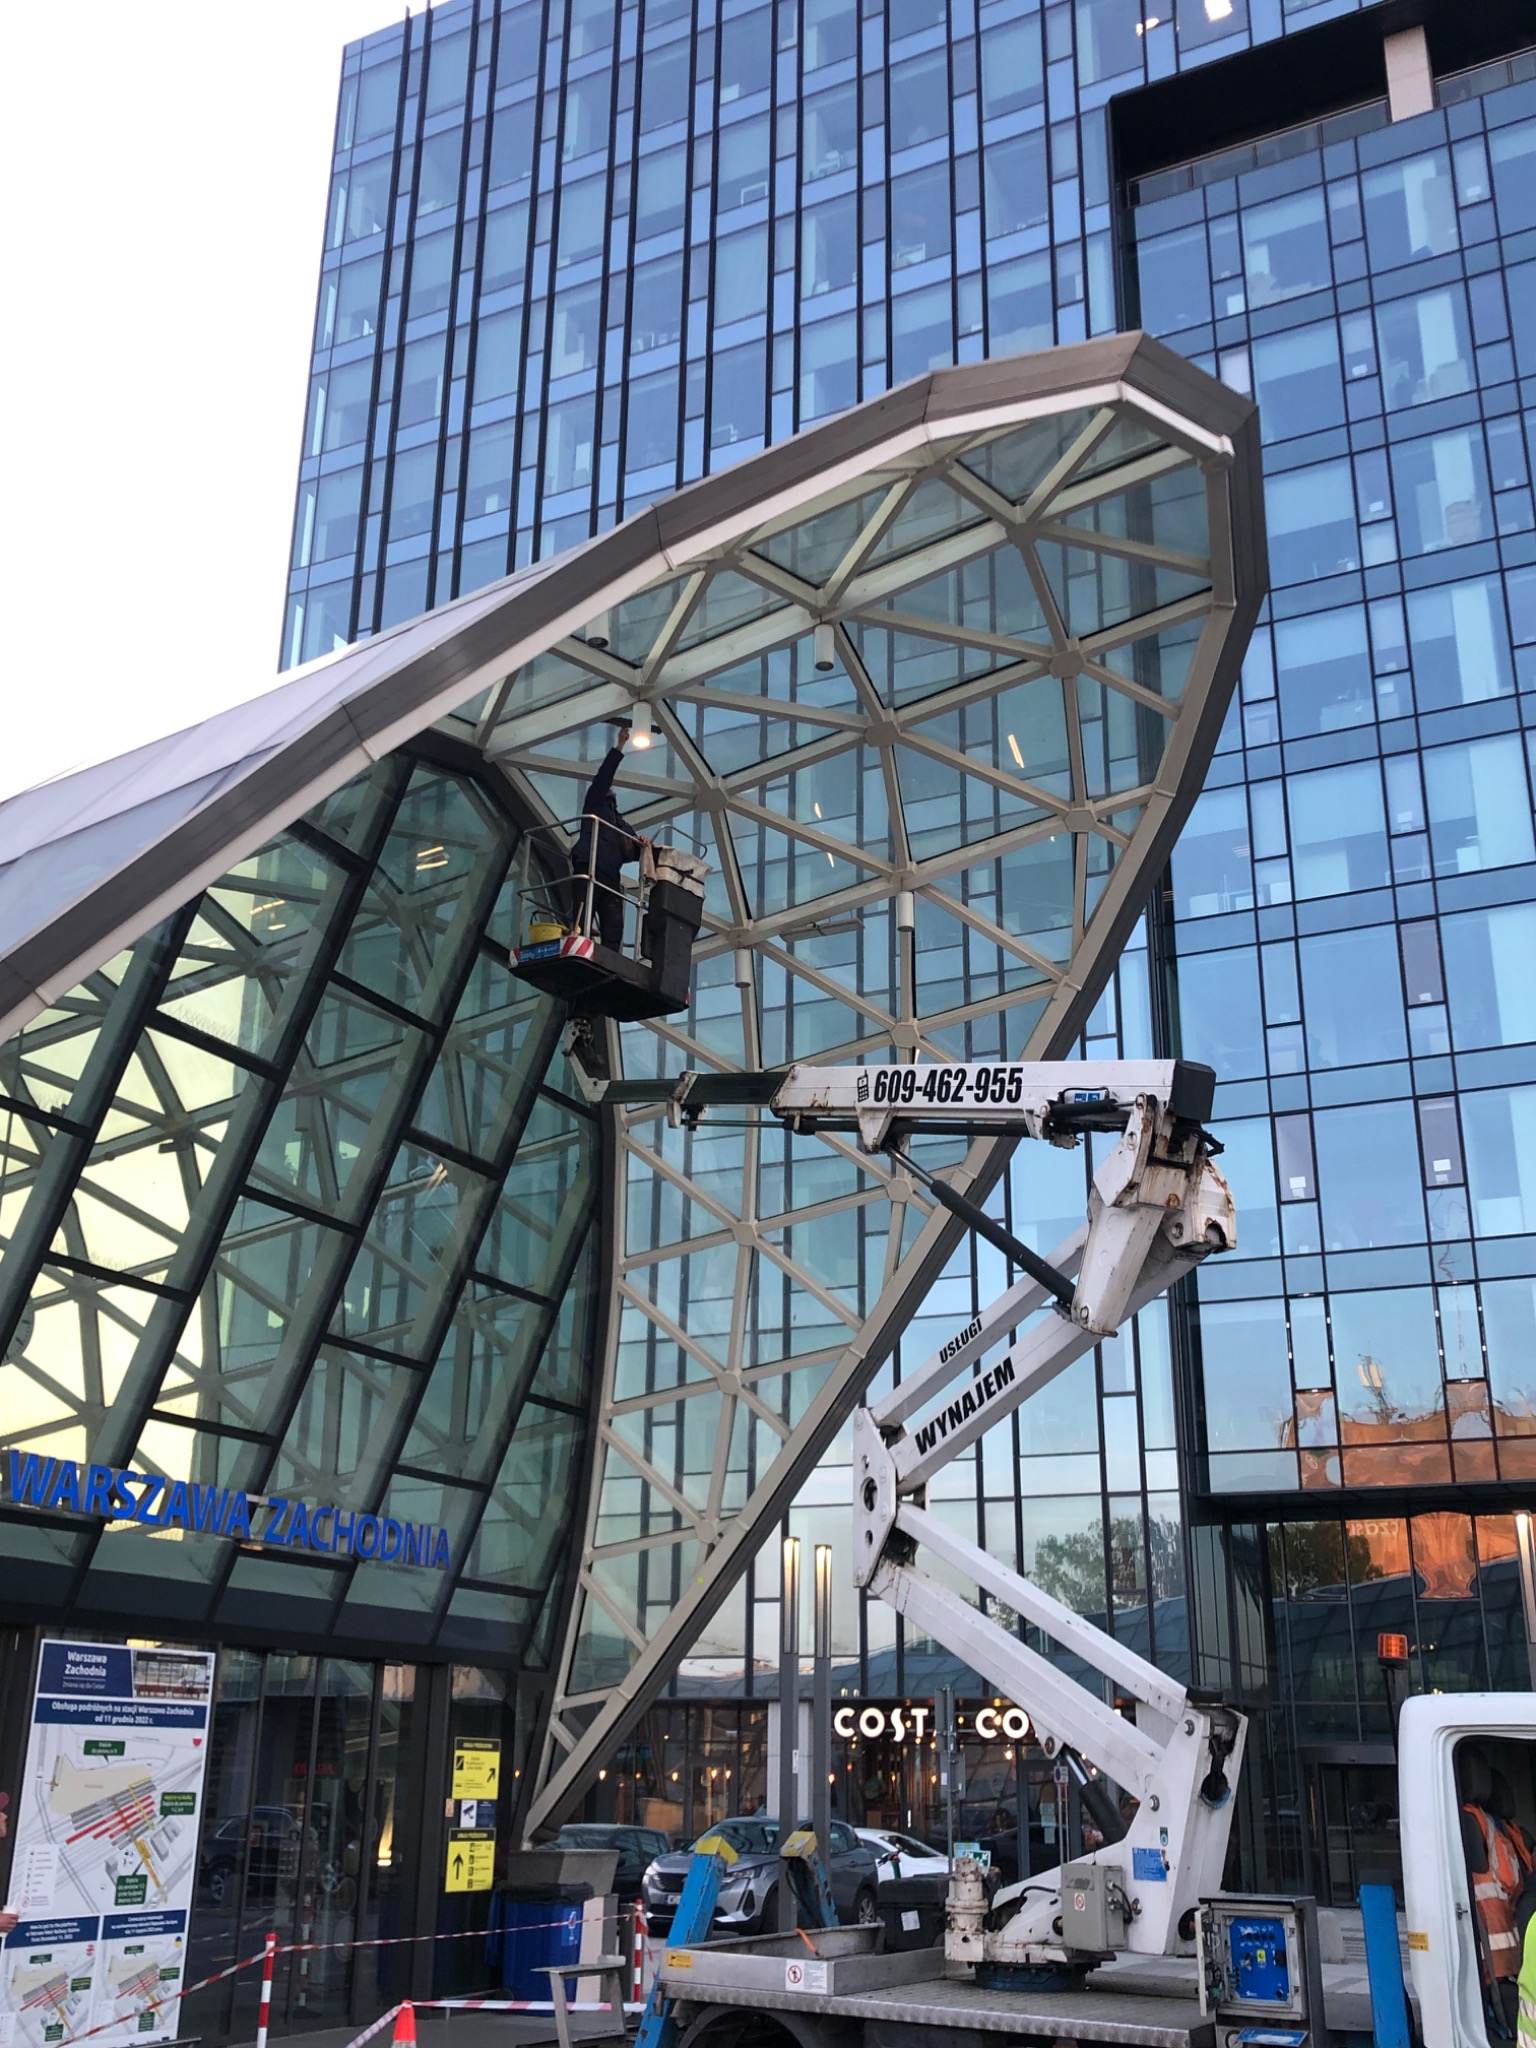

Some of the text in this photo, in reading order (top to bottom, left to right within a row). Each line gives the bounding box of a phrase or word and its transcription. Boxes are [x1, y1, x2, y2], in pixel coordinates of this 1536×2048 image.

[873, 1067, 1024, 1104] 609-462-955
[938, 1317, 983, 1364] USŁUGI
[914, 1355, 1016, 1456] WYNAJEM
[9, 1449, 451, 1569] WARSZAWA ZACHODNIA
[64, 1664, 107, 1677] Zachodnia
[67, 1651, 107, 1664] Warszawa
[833, 1707, 937, 1742] COST
